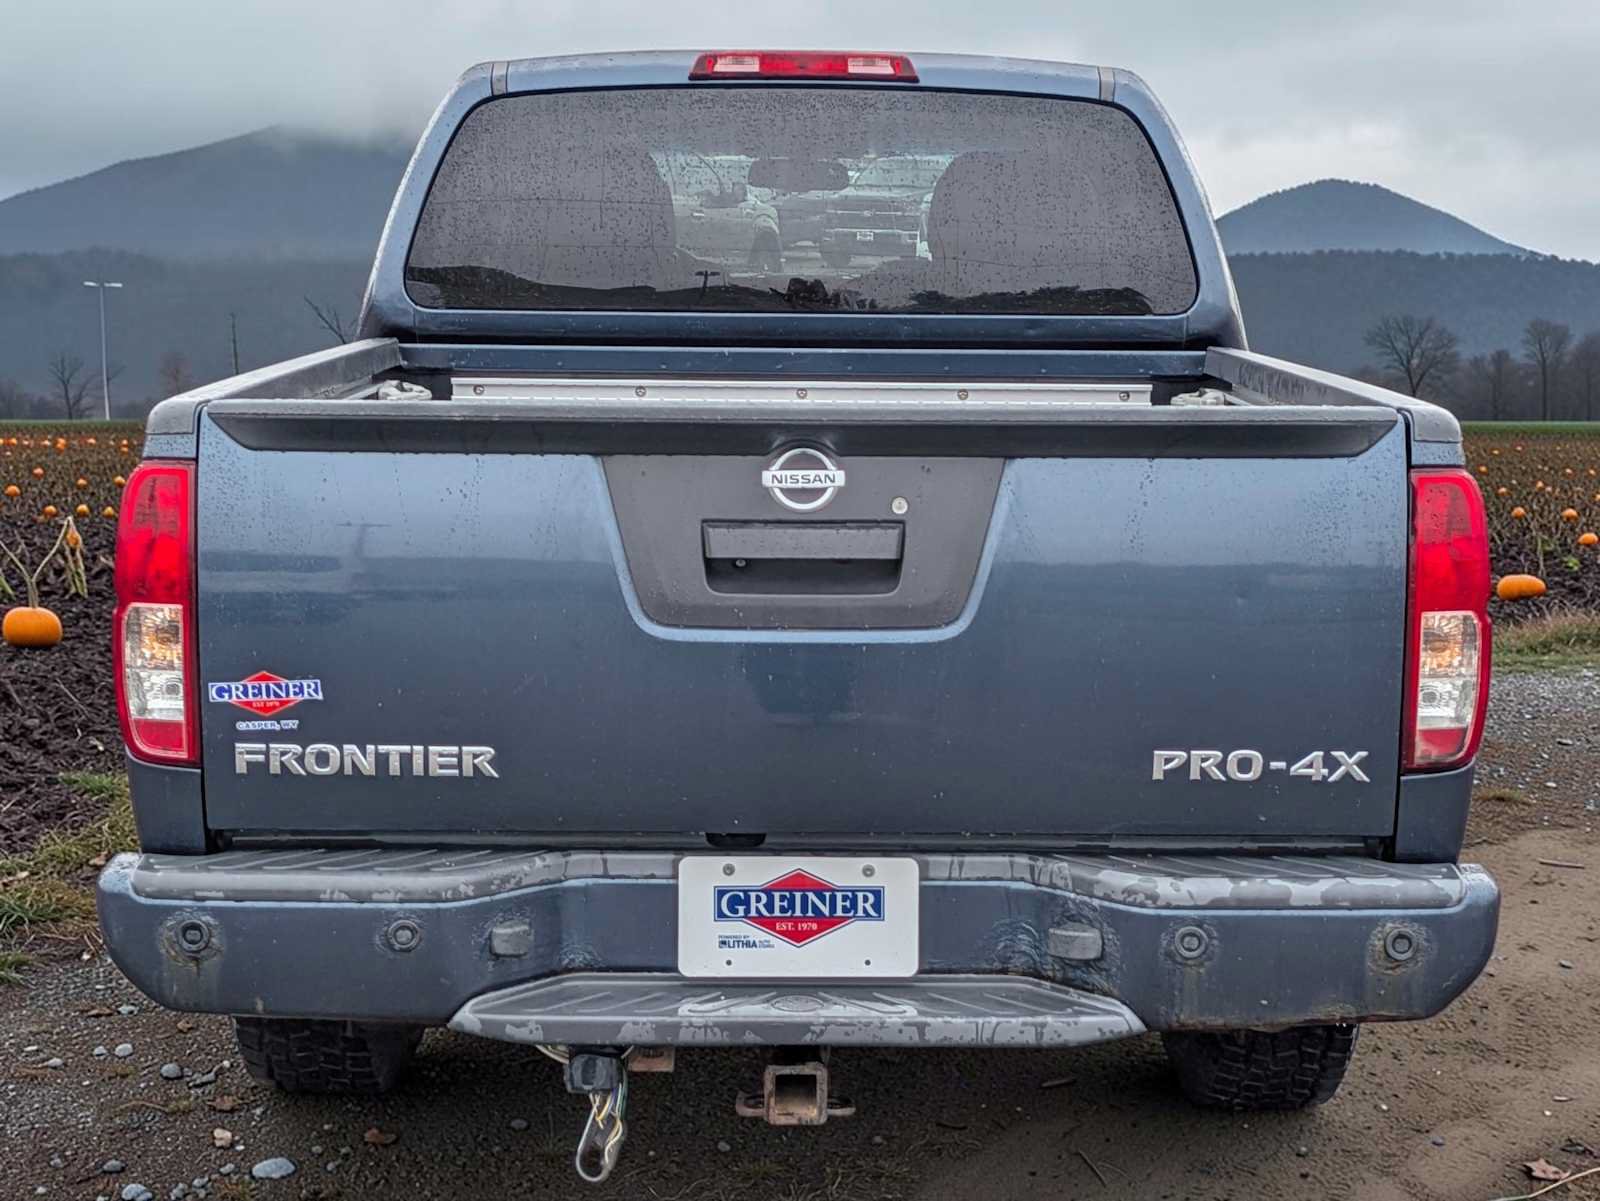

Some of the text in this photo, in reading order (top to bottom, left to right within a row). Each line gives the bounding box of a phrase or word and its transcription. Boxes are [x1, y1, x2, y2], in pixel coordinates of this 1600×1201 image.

[771, 473, 836, 484] NISSAN
[211, 681, 322, 701] GREINER
[236, 719, 299, 730] CASPER, WY
[234, 742, 499, 778] FRONTIER
[1152, 749, 1370, 782] PRO-4X
[720, 891, 879, 917] GREINER
[775, 922, 818, 931] EST. 1970
[728, 940, 757, 948] LITHIA
